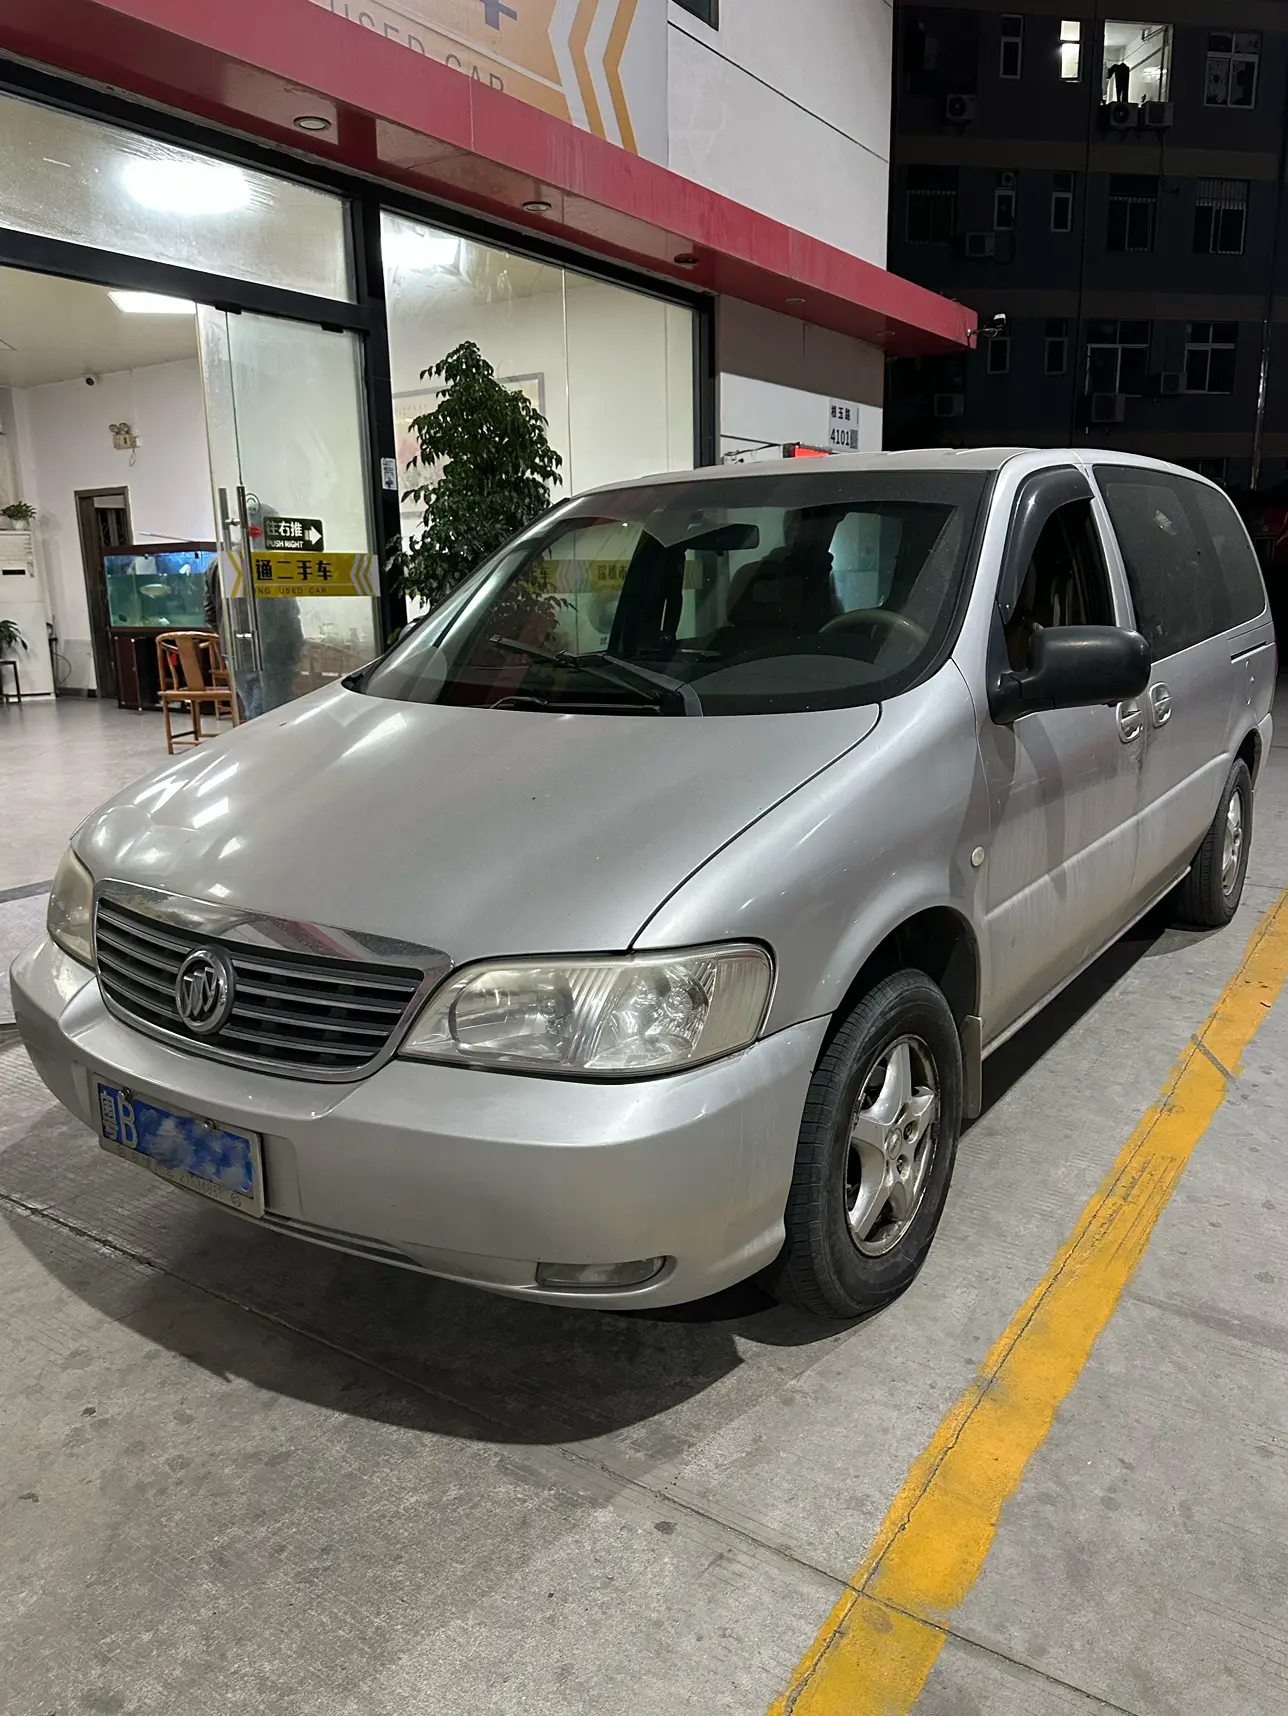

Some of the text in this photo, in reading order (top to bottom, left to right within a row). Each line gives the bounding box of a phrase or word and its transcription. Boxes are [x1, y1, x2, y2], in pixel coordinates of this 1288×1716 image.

[831, 428, 850, 446] 4101
[267, 540, 304, 549] PUSH RIGHT
[255, 559, 333, 581] 通二手车
[279, 587, 303, 595] USED
